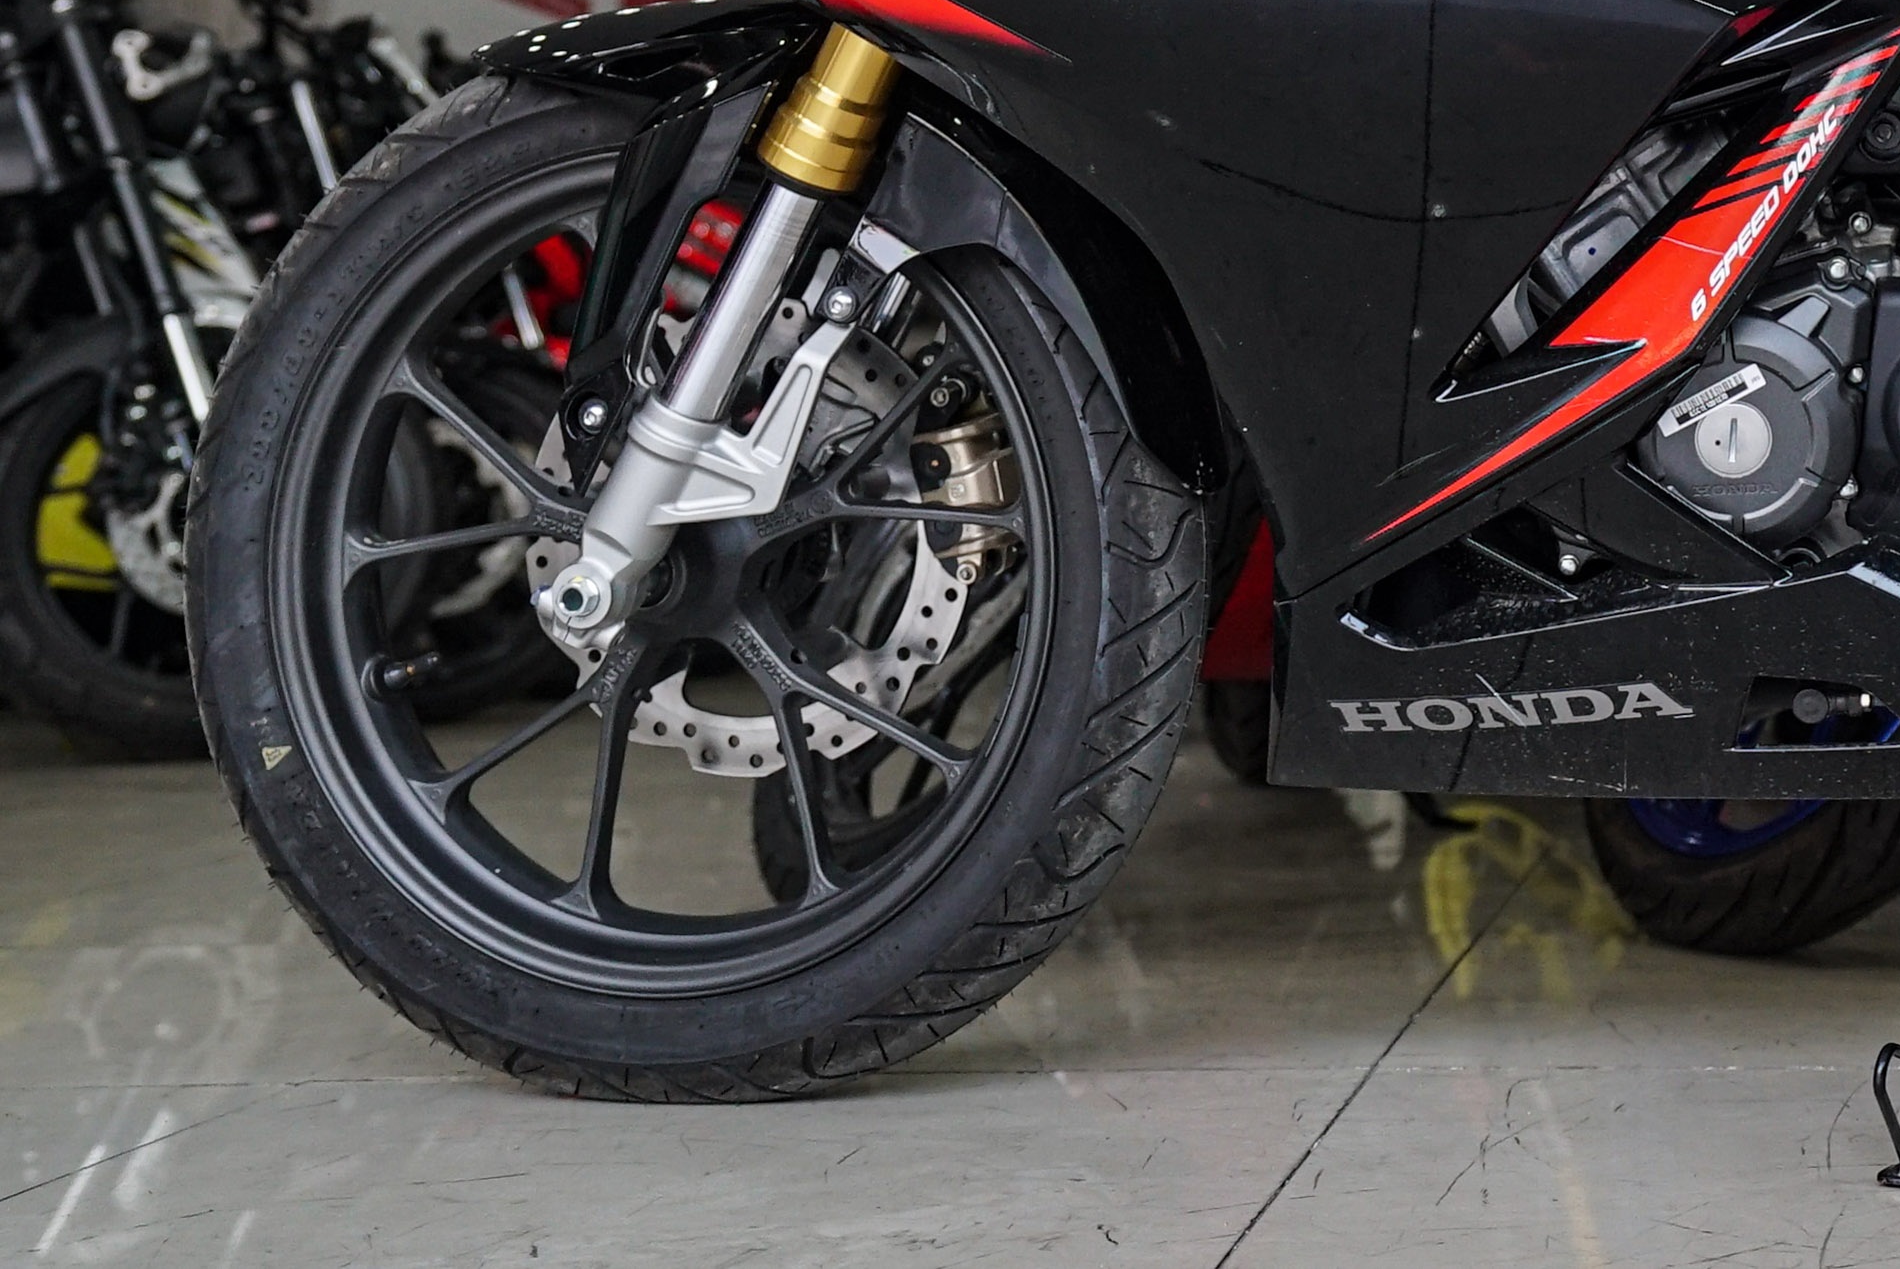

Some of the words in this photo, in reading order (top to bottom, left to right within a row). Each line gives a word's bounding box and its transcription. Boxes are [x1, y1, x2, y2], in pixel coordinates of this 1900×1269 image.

[1691, 288, 1707, 322] 6
[1709, 184, 1780, 298] SPEED
[1782, 104, 1838, 194] DOHC
[1692, 482, 1779, 497] HONDA
[1330, 682, 1694, 732] HONDA
